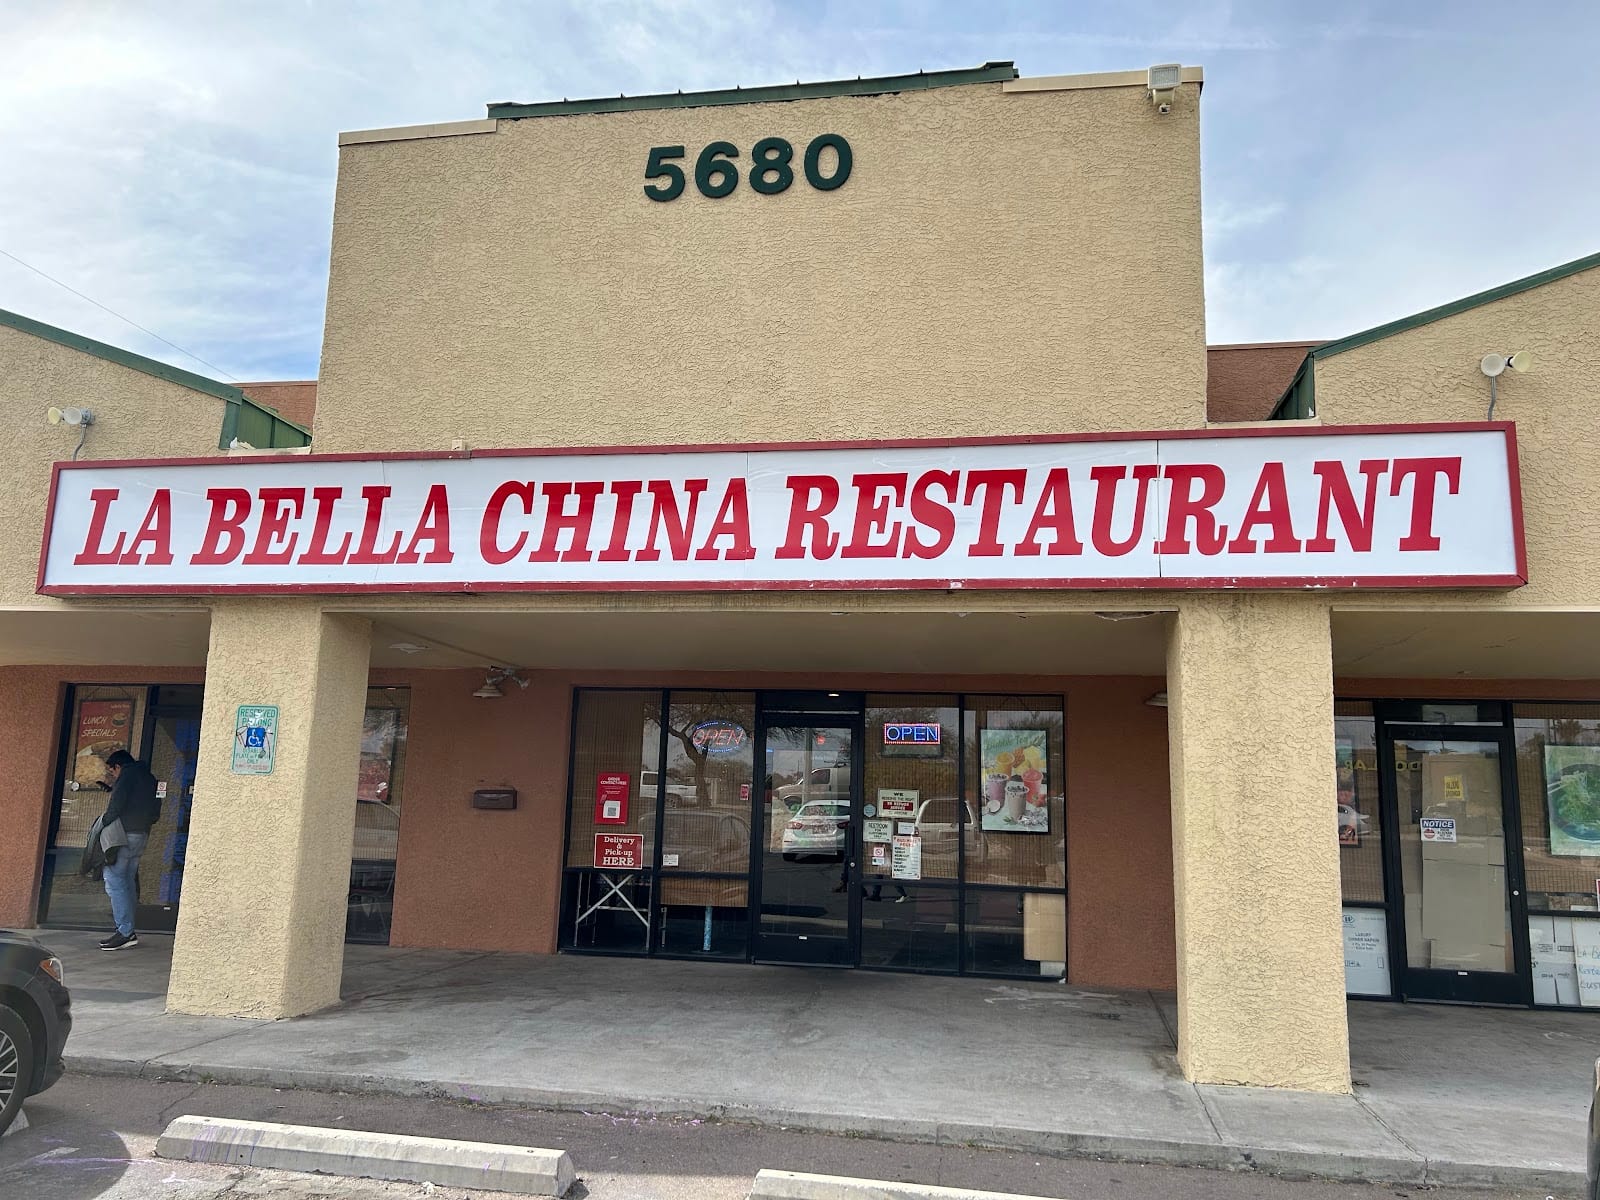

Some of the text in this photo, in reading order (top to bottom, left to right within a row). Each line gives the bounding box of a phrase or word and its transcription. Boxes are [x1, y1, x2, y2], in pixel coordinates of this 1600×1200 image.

[643, 133, 854, 203] 5680
[75, 456, 1462, 565] LA BELLA CHINA RESTAURANT
[83, 715, 108, 726] LUNCH
[82, 728, 118, 738] SPECIALS
[692, 728, 744, 746] OPEN
[886, 726, 938, 741] OPEN
[1423, 820, 1454, 829] NOTICE
[604, 836, 635, 845] Delivery
[604, 848, 633, 857] Pick-up
[602, 856, 635, 867] HERE
